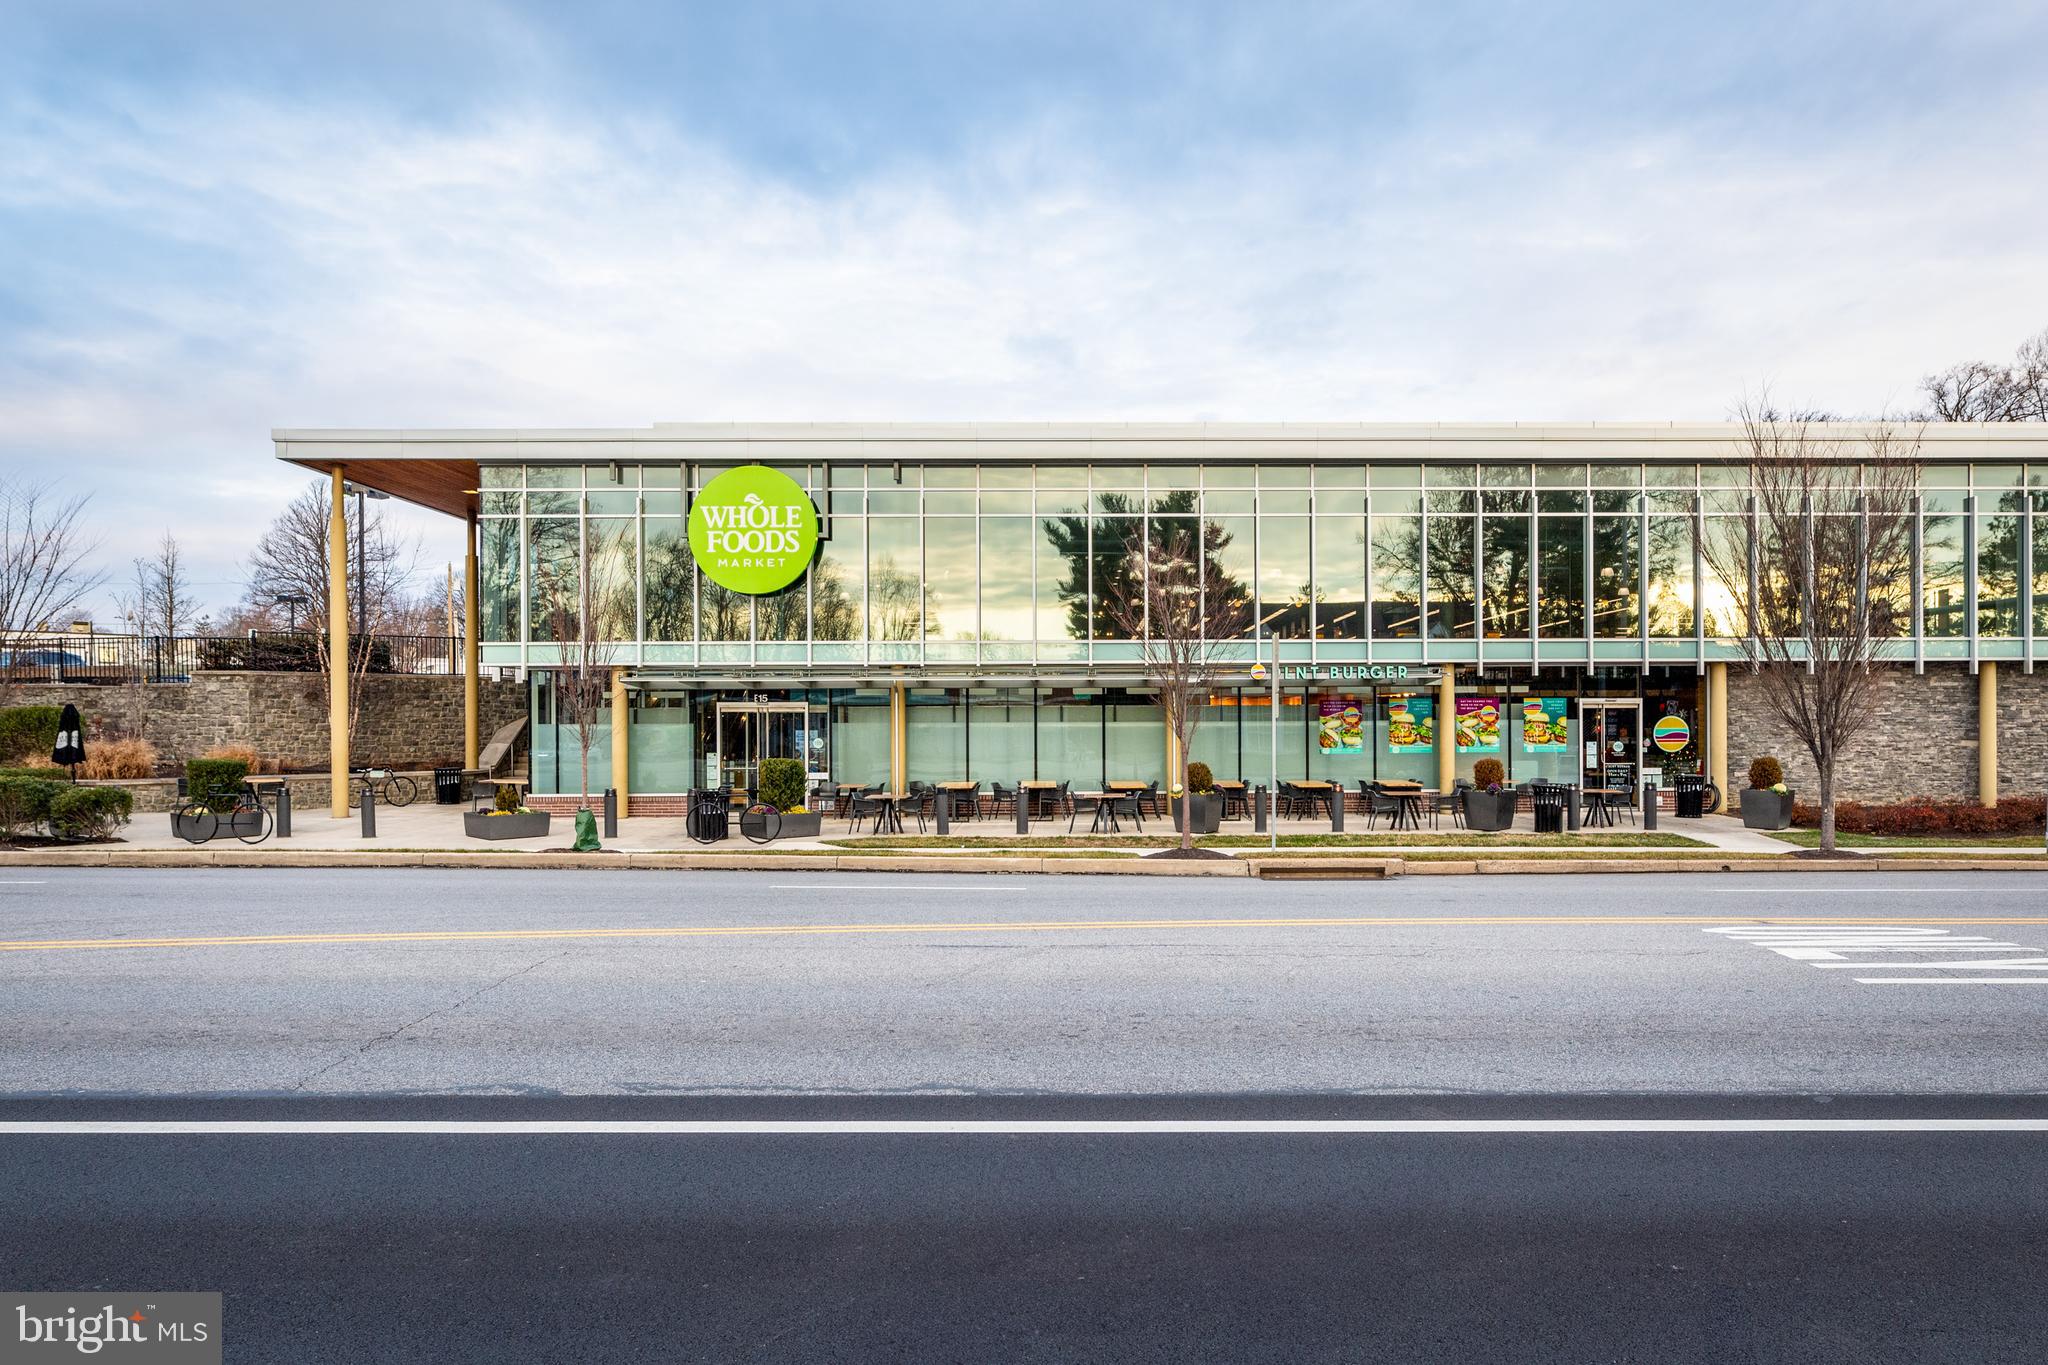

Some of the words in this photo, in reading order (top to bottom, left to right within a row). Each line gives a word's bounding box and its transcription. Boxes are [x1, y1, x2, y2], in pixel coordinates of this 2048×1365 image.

[700, 504, 802, 529] WHOLE
[706, 530, 800, 553] FOODS
[718, 558, 785, 568] MARKET
[1278, 666, 1319, 680] LNT
[1330, 665, 1408, 680] BURGER
[754, 693, 768, 703] E15
